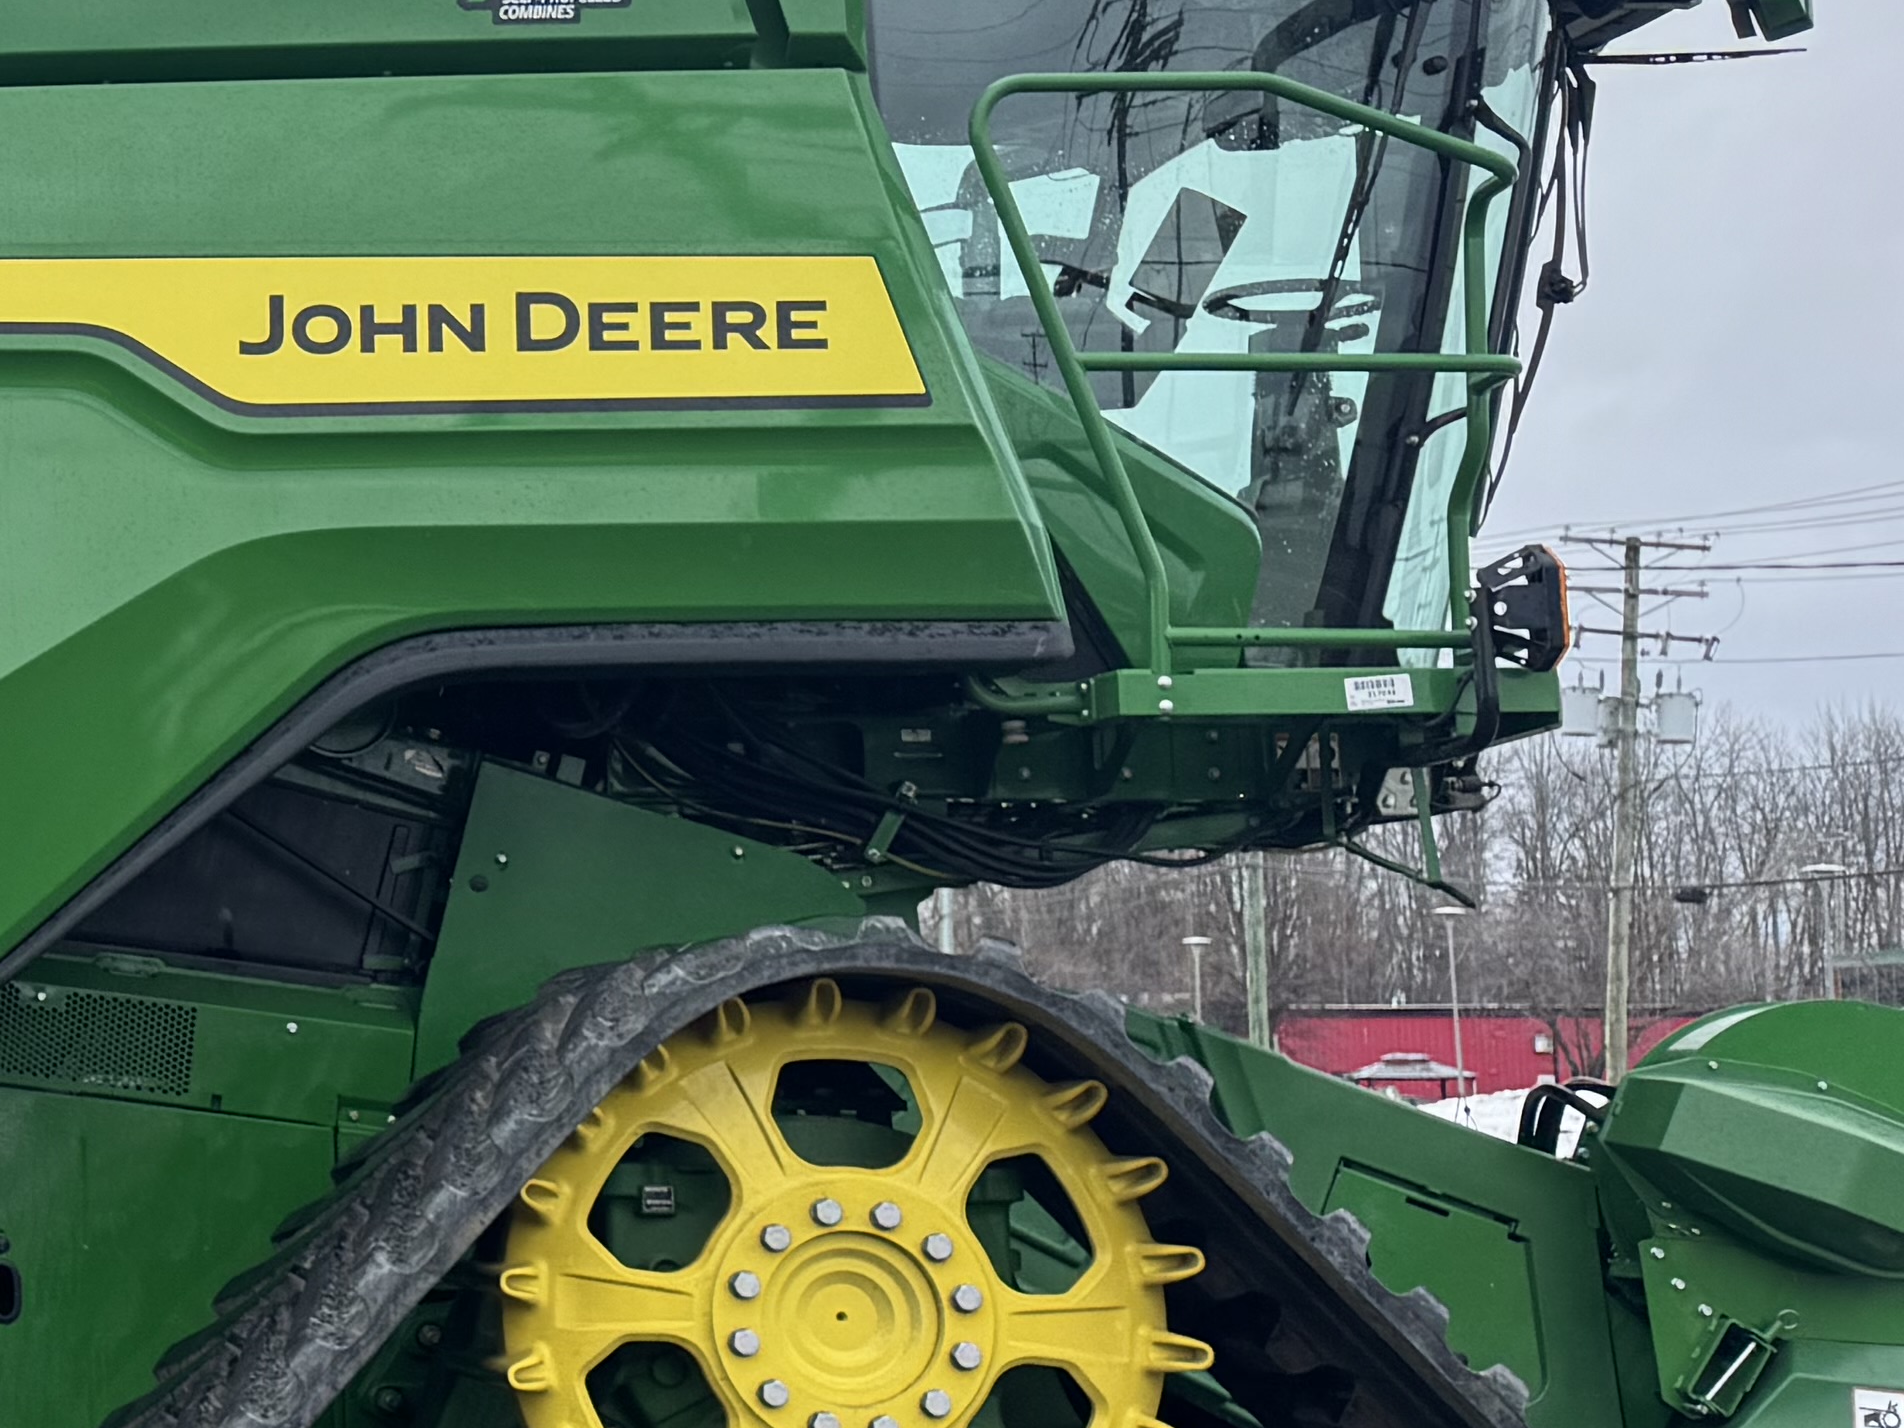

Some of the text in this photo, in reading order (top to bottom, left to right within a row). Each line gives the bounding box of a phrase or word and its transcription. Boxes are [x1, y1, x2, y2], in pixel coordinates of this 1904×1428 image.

[499, 5, 575, 20] COMBINES
[239, 291, 828, 355] JOHN DEERE
